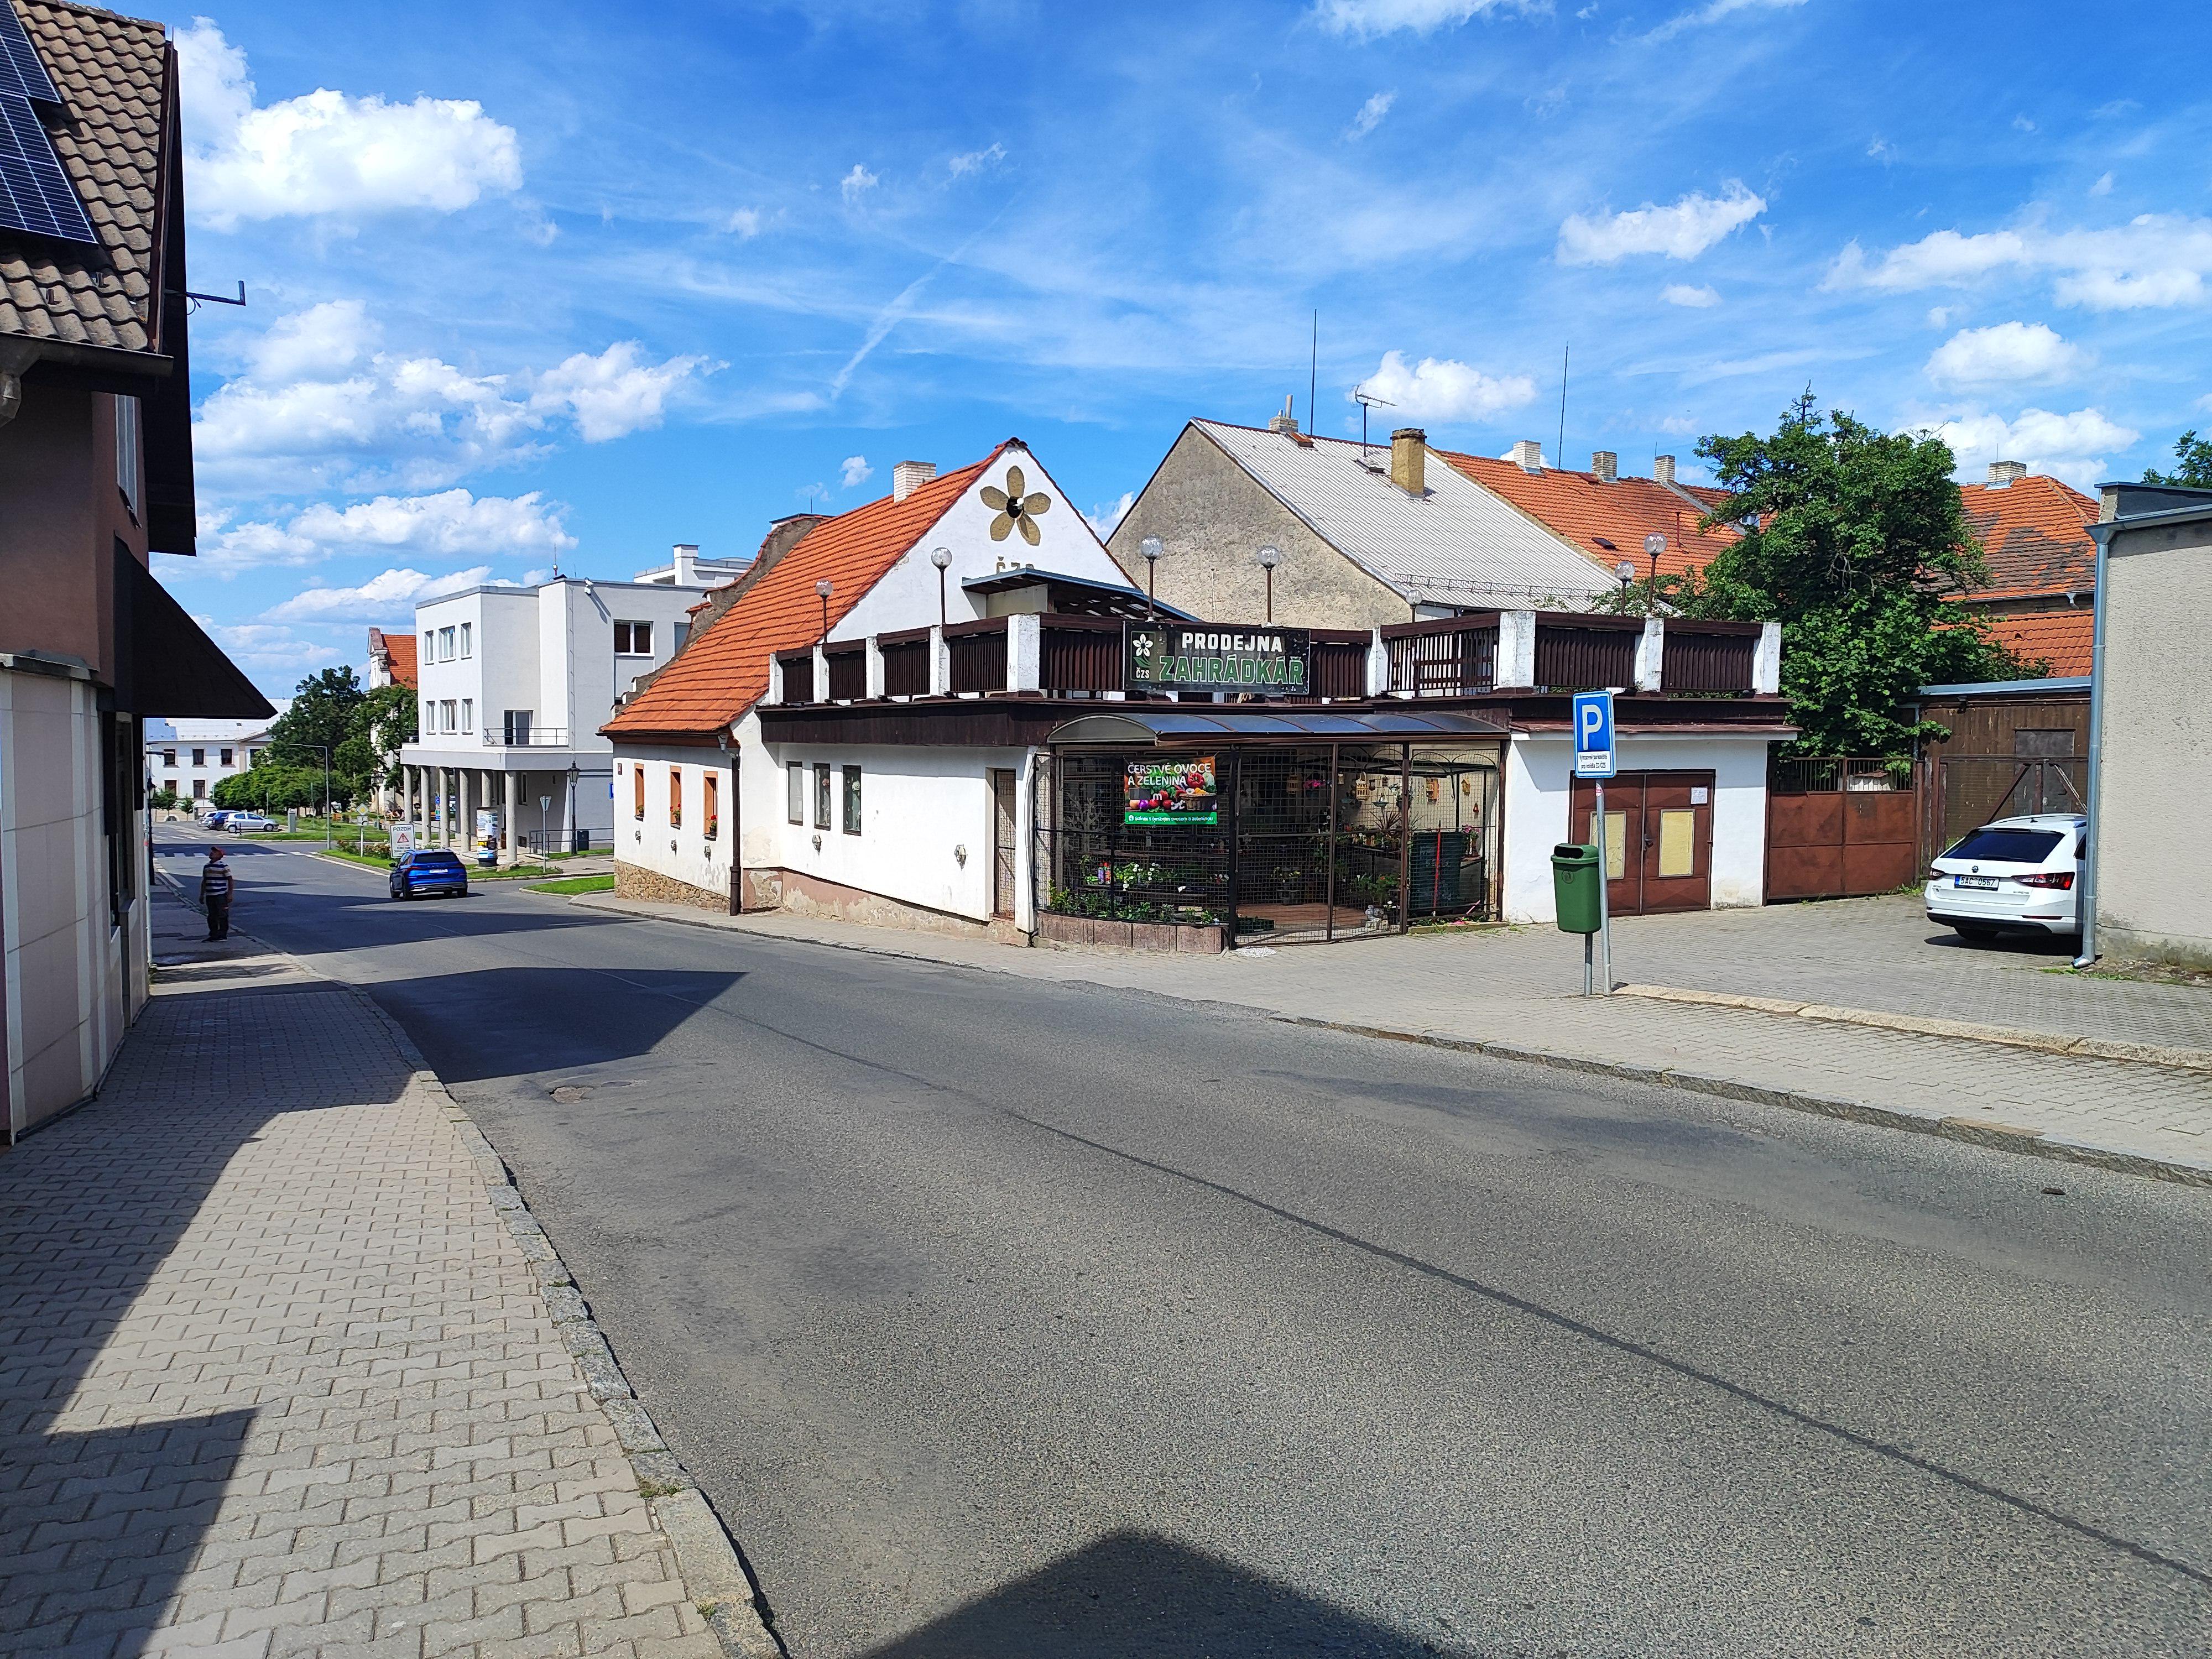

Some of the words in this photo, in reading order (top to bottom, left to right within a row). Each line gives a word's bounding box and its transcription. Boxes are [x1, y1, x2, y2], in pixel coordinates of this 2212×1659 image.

[1181, 632, 1283, 653] PRODEJNA
[1136, 667, 1150, 679] ČZS
[1159, 654, 1305, 685] ZAHRÁDKÁŘ
[1582, 704, 1603, 750] P
[1128, 761, 1171, 774] ČERSTVÉ
[1173, 763, 1212, 774] OVOCE
[1128, 775, 1135, 785] A
[1136, 775, 1187, 786] ZELENINA
[1961, 877, 1973, 885] 5AC
[1978, 878, 1996, 886] 0567
